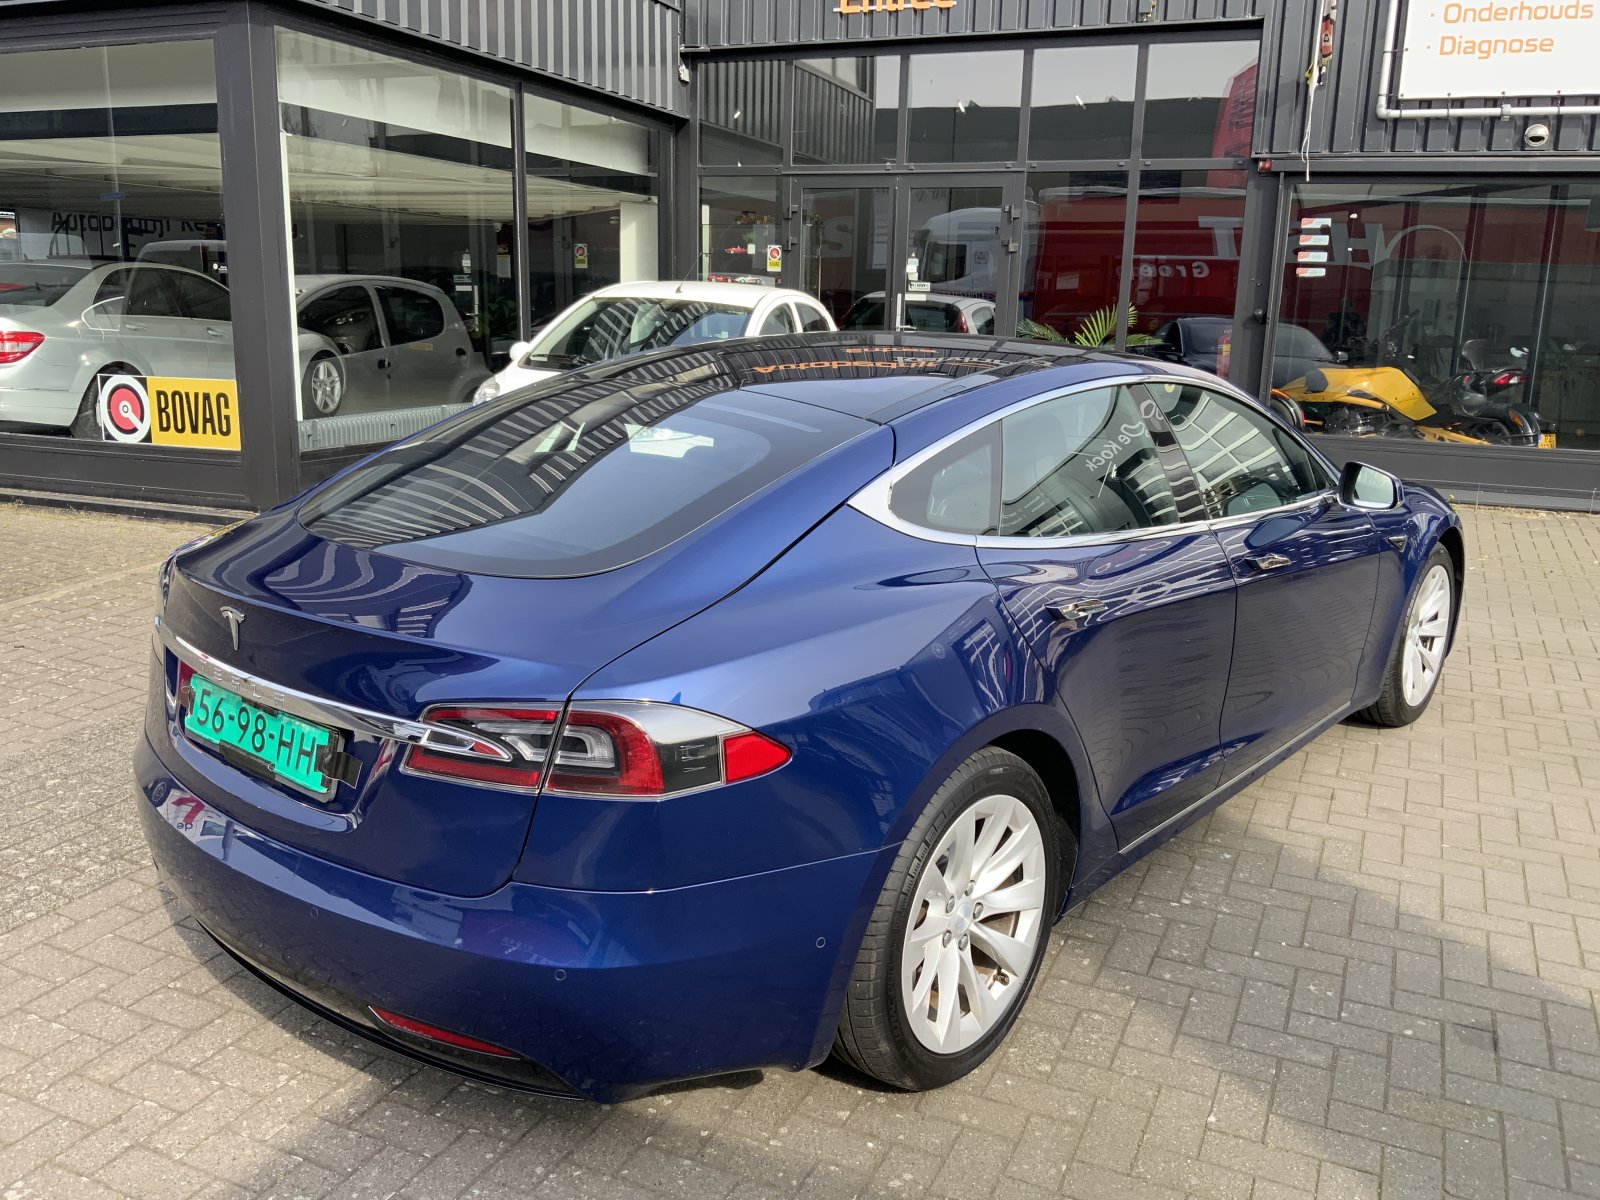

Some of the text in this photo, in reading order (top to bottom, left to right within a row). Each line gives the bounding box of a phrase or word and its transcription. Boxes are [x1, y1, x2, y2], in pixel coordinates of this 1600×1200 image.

[1444, 1, 1594, 24] Onderhouds
[1439, 35, 1555, 60] Diagnose
[156, 389, 232, 437] BOVAG
[199, 659, 288, 710] TESLA
[196, 688, 317, 777] 56-98-HH
